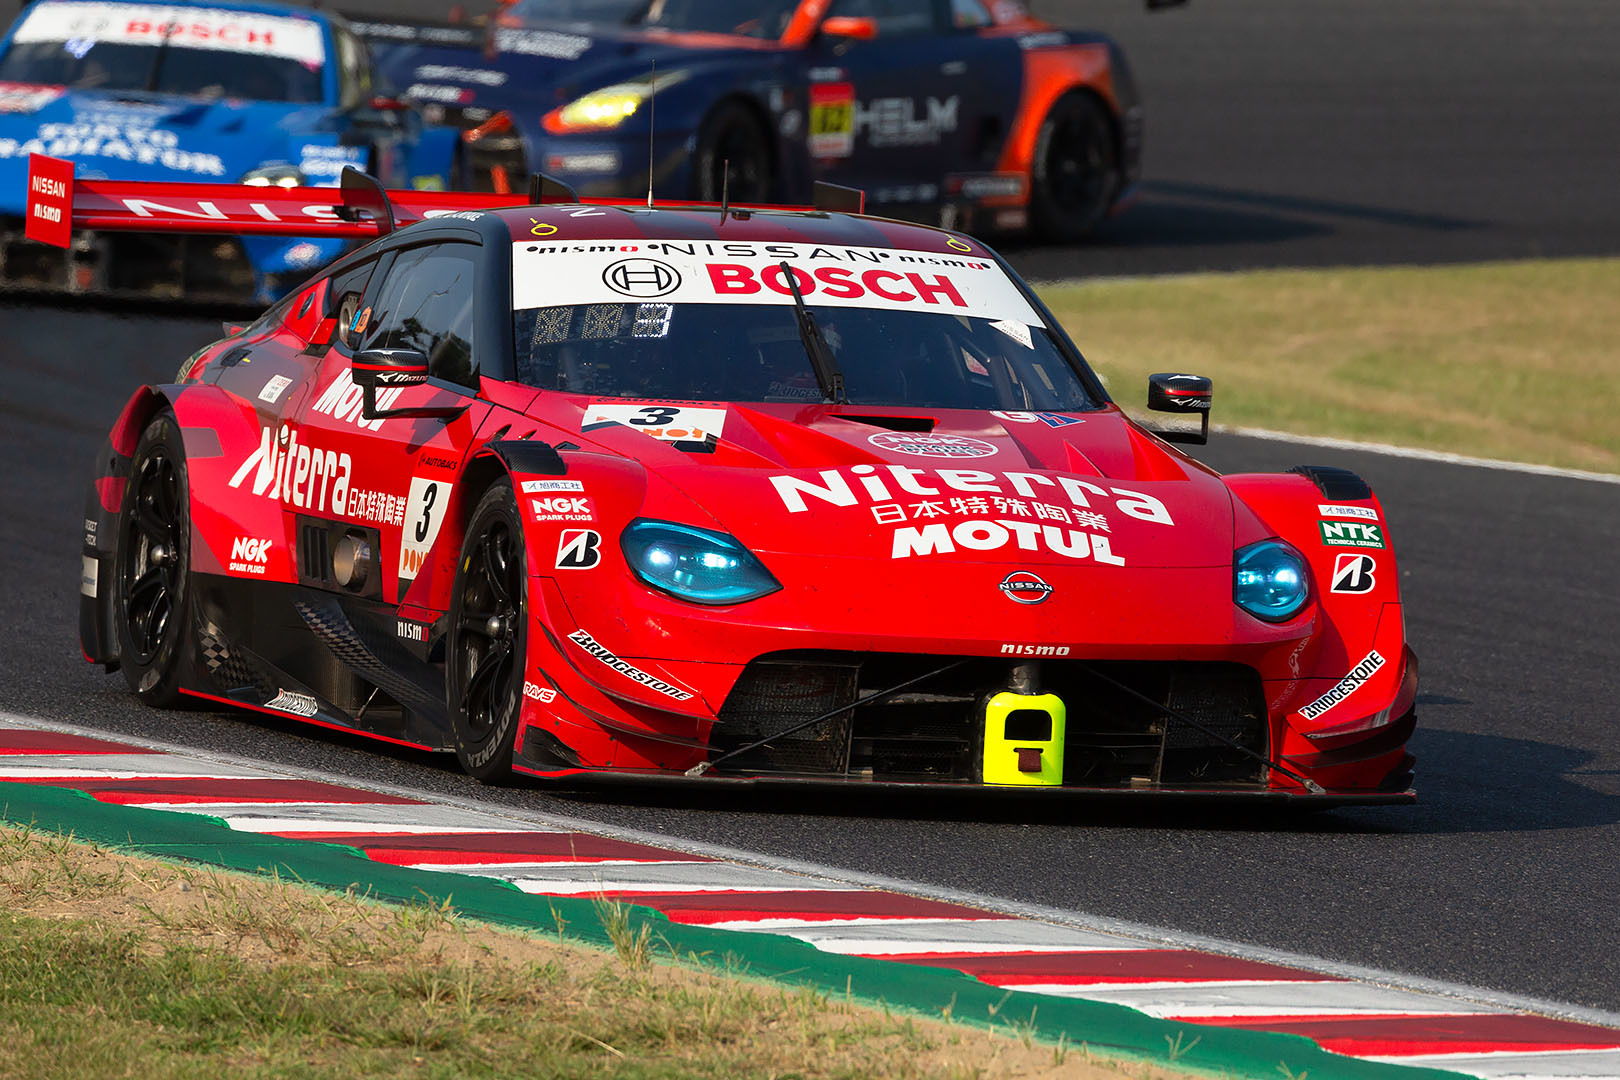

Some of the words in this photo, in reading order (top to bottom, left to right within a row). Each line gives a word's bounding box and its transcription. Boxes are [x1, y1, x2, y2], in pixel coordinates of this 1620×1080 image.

[126, 19, 275, 47] BOSCH
[855, 96, 959, 134] HELM
[32, 175, 66, 198] NISSAN
[34, 202, 62, 223] nismo
[661, 242, 882, 263] NISSAN
[705, 263, 969, 308] BOSCH
[629, 407, 681, 426] 3
[228, 423, 352, 516] Niterra
[425, 456, 458, 470] AUTOBACS
[347, 487, 407, 527] 日本特殊陶業
[531, 497, 591, 514] NGK
[768, 464, 1176, 526] Niterra
[415, 483, 438, 542] 3
[869, 496, 1113, 534] 日本特殊陶業
[891, 519, 1126, 567] MOTUL
[1322, 522, 1380, 541] NTK
[231, 536, 273, 564] NGK
[402, 548, 430, 574] PON
[229, 562, 248, 572] SPARK
[247, 564, 265, 574] PLUGS
[999, 582, 1053, 591] NISSAN
[397, 621, 429, 642] nismo
[1000, 643, 1070, 657] nismo
[567, 629, 694, 701] BRIDGESTONE
[523, 681, 557, 703] RAYS
[1297, 649, 1387, 721] BRIDGESTONE
